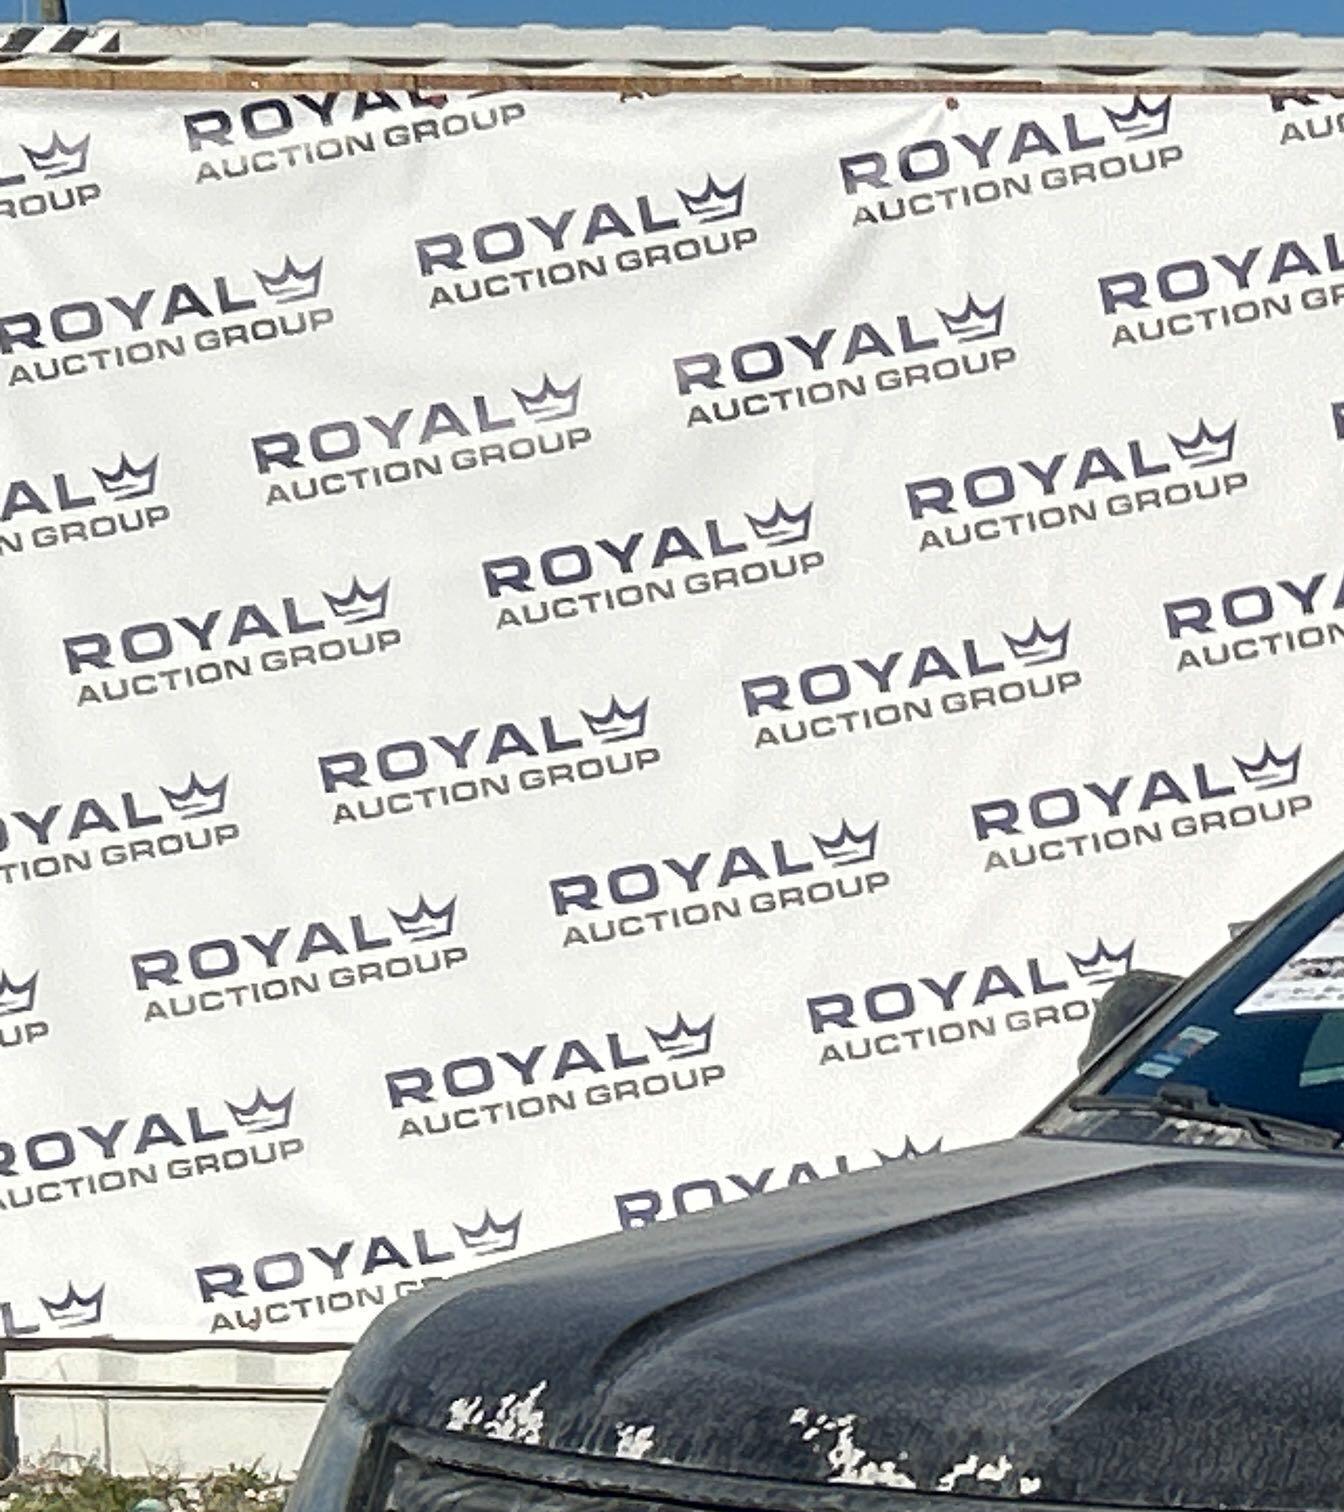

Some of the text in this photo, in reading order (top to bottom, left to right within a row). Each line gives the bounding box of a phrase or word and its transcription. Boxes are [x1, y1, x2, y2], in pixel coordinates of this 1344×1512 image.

[195, 102, 526, 185] AUCTION GROUP
[838, 112, 1106, 196] ROYAL
[0, 182, 102, 219] ROUP
[852, 144, 1184, 228] AUCTION GROUP
[414, 194, 682, 278] ROYAL
[429, 227, 758, 310] AUCTION GROUP
[0, 276, 258, 356] ROYAL
[8, 307, 334, 387] AUCTION GROUP
[672, 314, 940, 397] ROYAL
[1111, 293, 1292, 349] AUCTION
[686, 346, 1017, 429] AUCTION GROUP
[250, 395, 516, 475] ROYAL
[265, 427, 592, 507] AUCTION GROUP
[904, 439, 1172, 521] ROYAL
[919, 471, 1248, 553] AUCTION GROUP
[31, 504, 171, 549] GROUP
[481, 519, 749, 599] ROYAL
[496, 550, 825, 631] AUCTION GROUP
[62, 596, 326, 676] ROYAL
[77, 628, 401, 708] AUCTION GROUP
[741, 638, 1006, 718] ROYAL
[754, 670, 1082, 750] AUCTION GROUP
[317, 715, 584, 794] ROYAL
[332, 747, 661, 825] AUCTION GROUP
[0, 791, 164, 852] YAL
[970, 762, 1237, 842] ROYAL
[984, 794, 1313, 873] AUCTION GROUP
[0, 823, 240, 884] TION GROUP
[548, 839, 814, 917] ROYAL
[562, 871, 890, 948] AUCTION GROUP
[130, 913, 393, 992] ROYAL
[144, 947, 468, 1023] AUCTION GROUP
[806, 957, 1070, 1035] ROYAL
[819, 998, 1097, 1066] AUCTION GRO
[384, 1032, 651, 1110] ROYAL
[398, 1064, 726, 1140] AUCTION GROUP
[0, 1138, 305, 1211] UCTION GROUP
[194, 1228, 456, 1304] ROYAL
[209, 1285, 385, 1334] AUCTION
